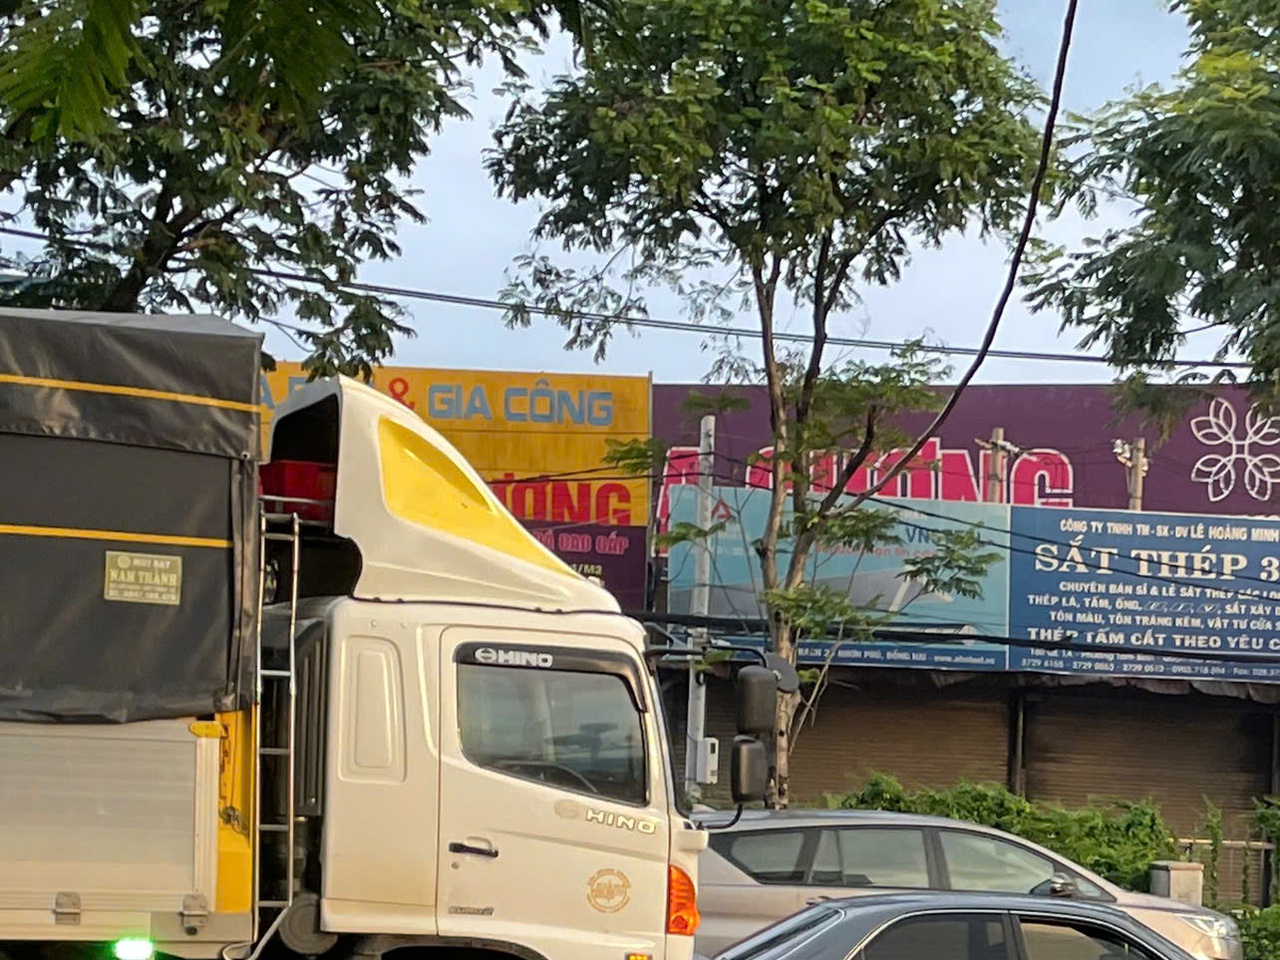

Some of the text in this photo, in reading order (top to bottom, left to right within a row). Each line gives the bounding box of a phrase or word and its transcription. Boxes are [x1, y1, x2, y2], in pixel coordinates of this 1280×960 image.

[428, 384, 493, 421] GIA
[504, 378, 613, 426] CÔNG
[1060, 518, 1087, 533] CÔNG
[1090, 521, 1104, 534] TY
[1107, 522, 1133, 536] TNHH
[1208, 525, 1248, 541] HOÀNG
[1250, 528, 1280, 542] MINH
[1034, 535, 1119, 575] SẮT
[1130, 544, 1248, 580] THÉP
[1059, 580, 1106, 593] CHUYÊN
[1109, 580, 1133, 595] BÁN
[1149, 586, 1159, 596] &
[1027, 593, 1059, 606] THÉP
[1249, 603, 1272, 616] XÂY
[1049, 610, 1073, 622] TÔN
[1108, 613, 1133, 625] TÔN
[1207, 617, 1229, 631] VẬT
[1027, 626, 1079, 641] THÉP
[1085, 626, 1125, 644] TẤM
[1130, 628, 1167, 646] CẮT
[1172, 634, 1222, 648] THEO
[1226, 633, 1264, 650] YÊU
[499, 650, 553, 668] HINO
[586, 808, 656, 834] HINO
